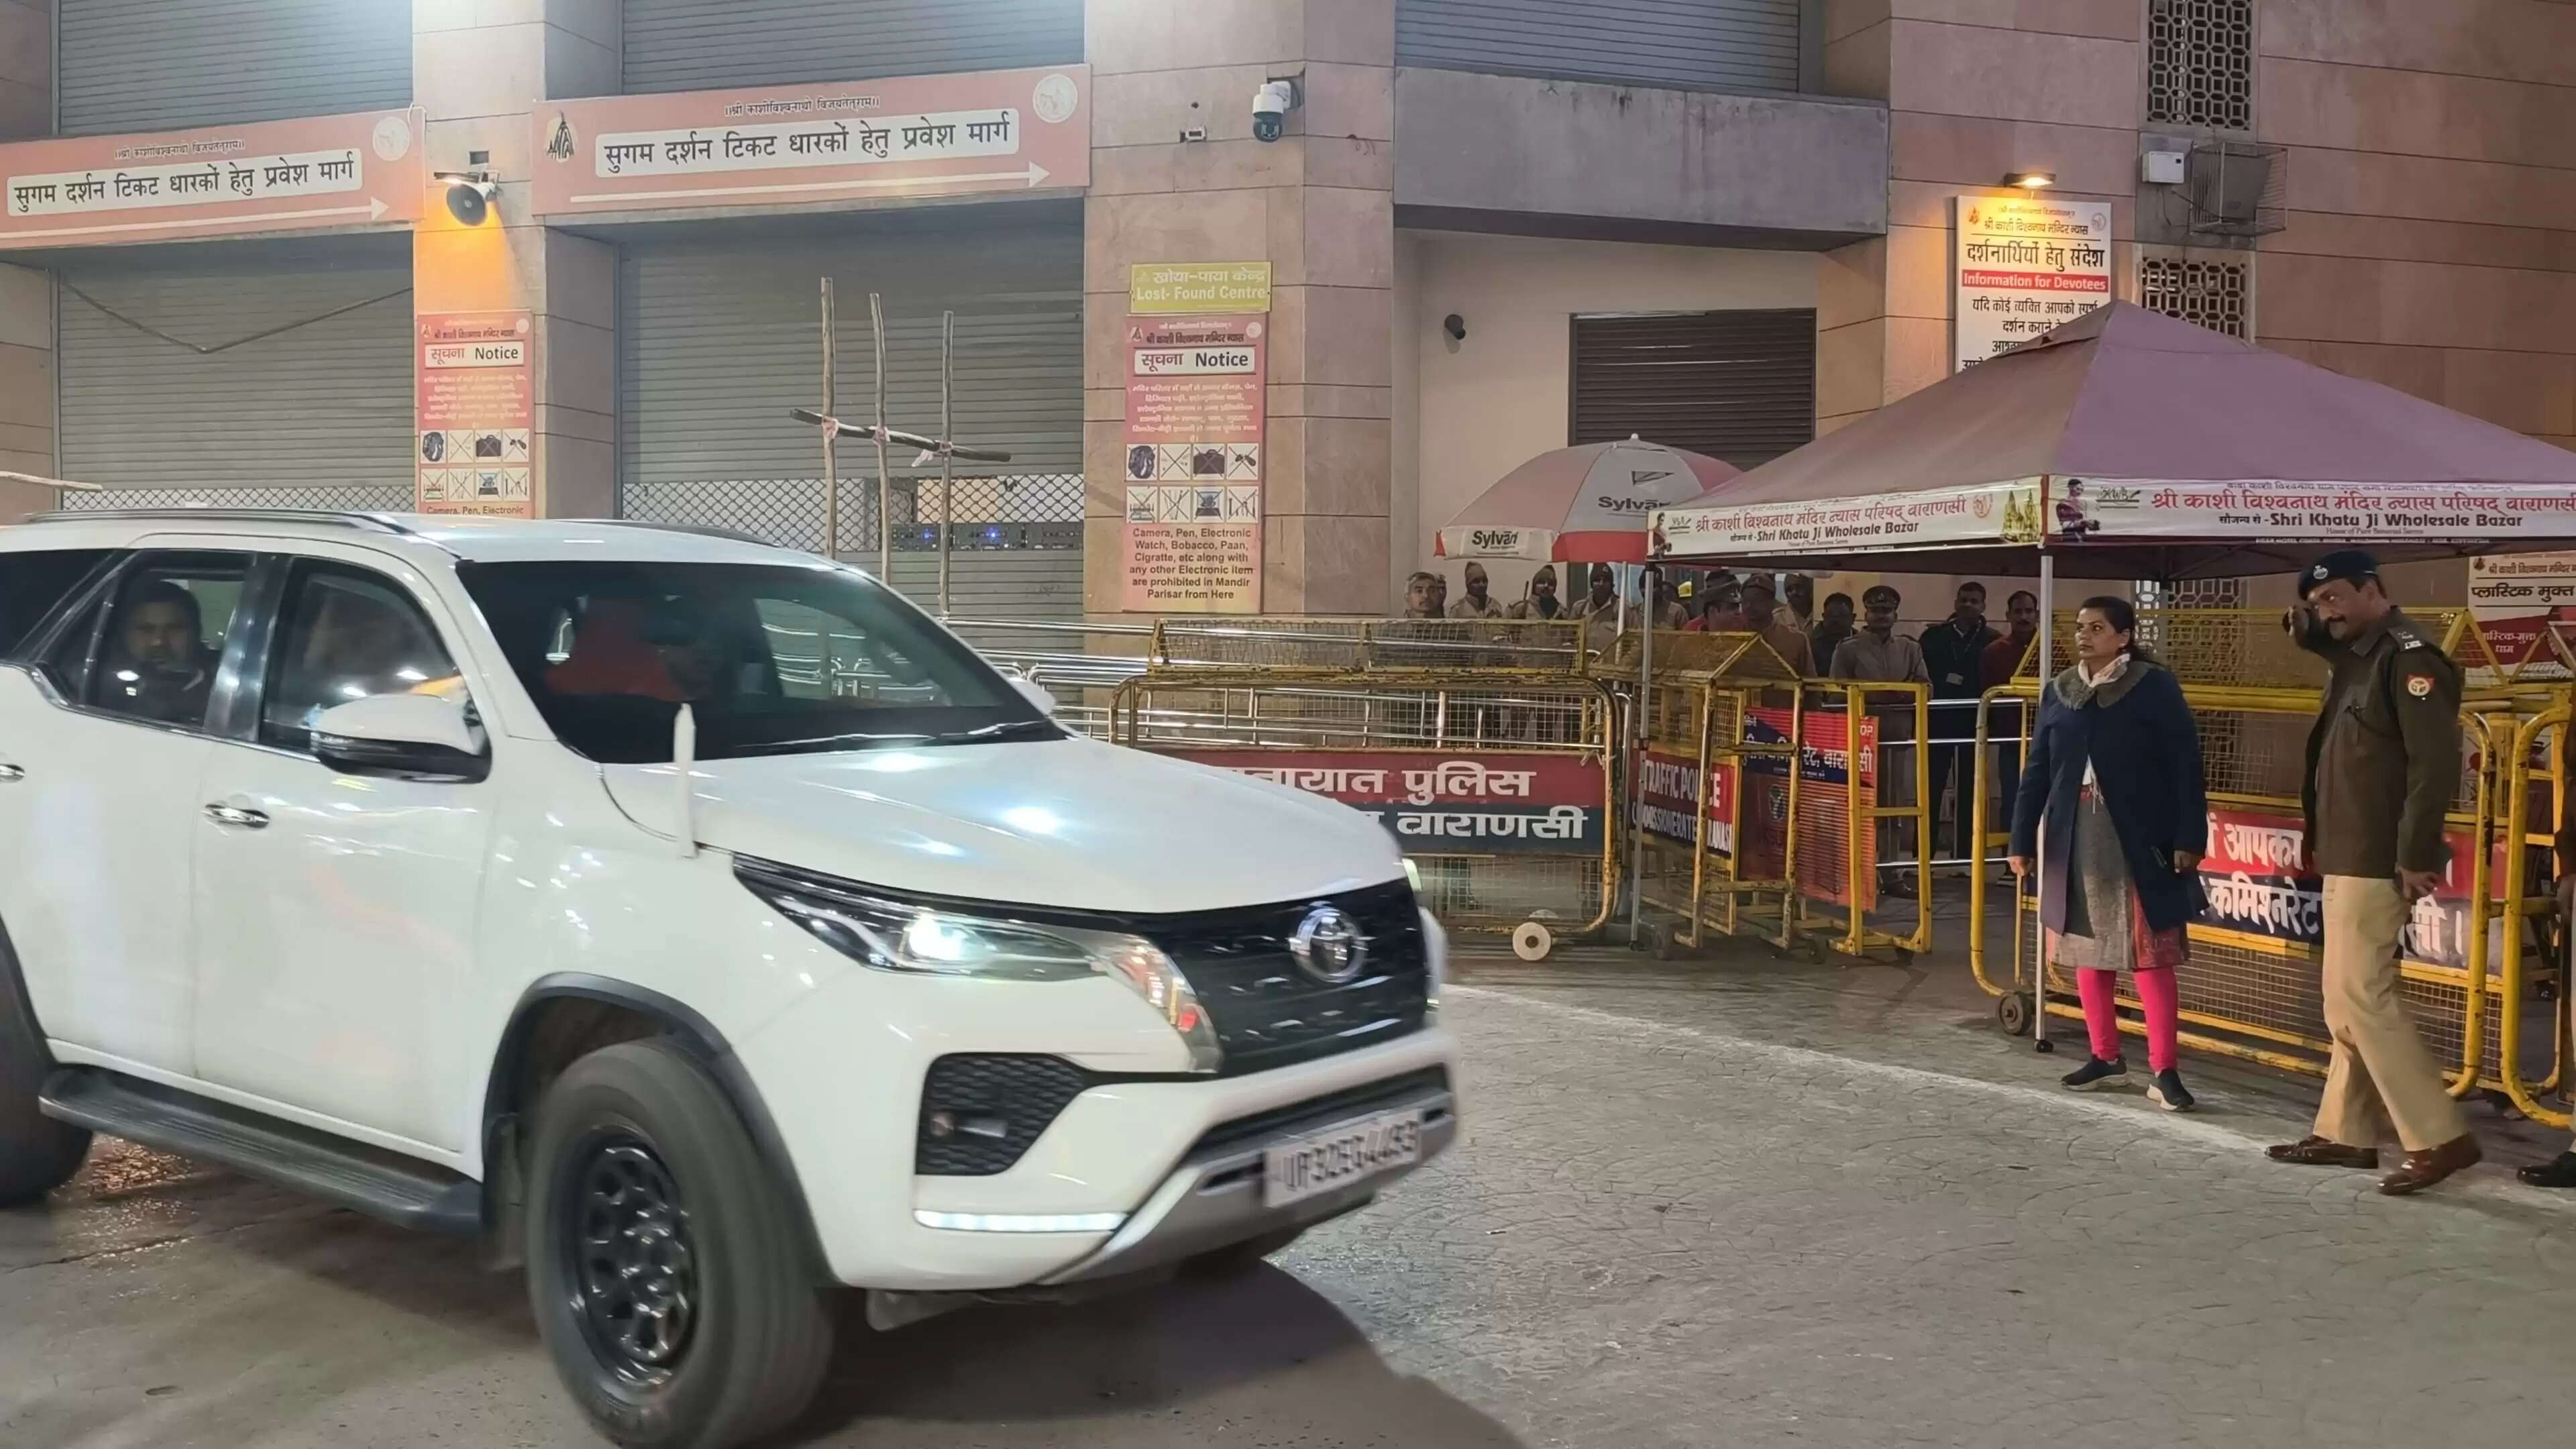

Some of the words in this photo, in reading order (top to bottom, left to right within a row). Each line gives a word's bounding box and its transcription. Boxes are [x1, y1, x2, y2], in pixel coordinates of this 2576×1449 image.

[604, 144, 655, 173] सुगम
[665, 131, 712, 163] दर्शन
[723, 131, 777, 159] टिकट
[790, 121, 849, 154] धारकों
[860, 119, 890, 156] हेतु
[902, 115, 955, 149] प्रवेश
[967, 109, 1010, 142] मार्ग
[15, 185, 56, 213] सुगम
[66, 173, 105, 202] दर्शन
[114, 173, 159, 197] टिकट
[170, 165, 221, 193] धारकों
[229, 164, 255, 195] हेतु
[264, 157, 309, 188] प्रवेश
[317, 152, 354, 180] मार्ग
[2045, 241, 2065, 272] हेतु
[2070, 243, 2105, 268] संदेश
[1964, 273, 2032, 286] Information
[2035, 277, 2051, 288] for
[2054, 277, 2106, 290] Devotees
[1175, 286, 1214, 299] Found
[1220, 286, 1266, 299] Centre
[1972, 296, 1990, 311] यदि
[1993, 297, 2010, 313] कोई
[2045, 300, 2075, 315] आपको
[2002, 317, 2025, 333] दर्शन
[430, 347, 464, 365] सूचना
[475, 347, 519, 360] Notice
[1141, 353, 1183, 372] सूचना
[1195, 352, 1248, 367] Notice
[482, 506, 524, 515] Electronic
[2151, 488, 2179, 508] श्री
[2184, 488, 2238, 510] काशी
[2241, 488, 2328, 510] विश्वनाथ
[2334, 490, 2381, 512] मंदिर
[2387, 496, 2436, 511] न्यास
[2440, 491, 2508, 517] परिषद्
[1695, 517, 1711, 533] श्री
[1711, 514, 1741, 532] काशी
[1743, 513, 1793, 531] विश्वनाथ
[1796, 508, 1827, 527] मंदिर
[1829, 508, 1861, 525] न्यास
[1865, 503, 1908, 527] परिषद्
[1908, 494, 1967, 517] वाराणसी
[2309, 513, 2359, 526] Khatu
[2366, 513, 2379, 529] Ji
[2384, 513, 2469, 526] Wholesale
[2476, 514, 2522, 526] Bazar
[1133, 529, 1173, 538] Camera,
[1177, 529, 1197, 538] Pen,
[1201, 529, 1250, 537] Electronic
[1778, 524, 1809, 541] Khatu
[1811, 524, 1822, 541] Ji
[1824, 521, 1881, 539] Wholesale
[1884, 520, 1919, 534] Bazar
[1136, 541, 1168, 550] Watch,
[1172, 541, 1218, 550] Bobacco,
[1221, 541, 1248, 550] Paan,
[1197, 553, 1224, 563] along
[1228, 553, 1248, 561] with
[1130, 567, 1146, 575] any
[1150, 566, 1175, 574] other
[1179, 566, 1228, 574] Electronic
[1150, 578, 1200, 588] prohibited
[1204, 578, 1213, 586] in
[1216, 578, 1250, 586] Mandir
[2471, 582, 2533, 598] प्लास्टिक
[2538, 586, 2575, 602] मुक्त
[1148, 590, 1182, 598] Parisar
[1185, 590, 1208, 598] from
[1211, 590, 1234, 598] Here
[1401, 761, 1536, 804] पुलिस
[1644, 759, 1678, 798] TRAFFIC
[1397, 805, 1589, 839] वाराणसी
[2224, 823, 2304, 871] आपका
[2208, 871, 2322, 936] कमिश्नरेट
